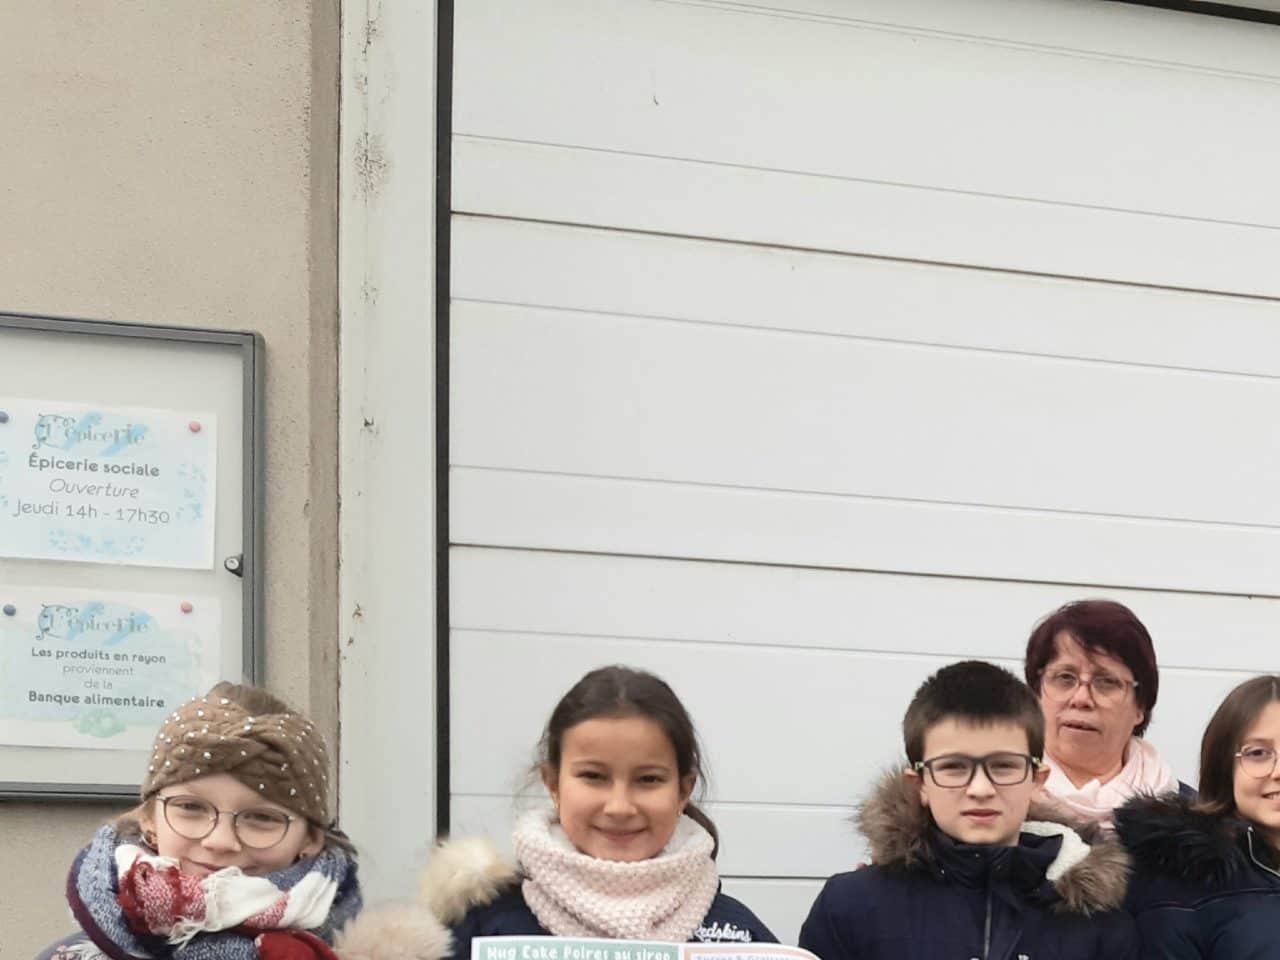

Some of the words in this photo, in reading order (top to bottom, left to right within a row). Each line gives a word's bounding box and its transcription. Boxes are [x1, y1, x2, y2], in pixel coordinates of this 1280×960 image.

[29, 452, 99, 473] Épicerie
[103, 462, 161, 478] sociale
[48, 478, 140, 499] Ouverture
[12, 499, 60, 517] Jeudi
[65, 504, 98, 519] 14h
[116, 508, 171, 524] 17h30
[31, 647, 52, 658] Les
[56, 648, 110, 661] produits
[113, 653, 129, 662] en
[131, 654, 167, 665] rayon
[62, 664, 135, 676] proviennent
[83, 679, 100, 690] de
[103, 679, 113, 690] la
[28, 690, 81, 706] Banque
[84, 693, 166, 709] alimentaire
[522, 944, 558, 960] Cake
[563, 945, 609, 960] Poires
